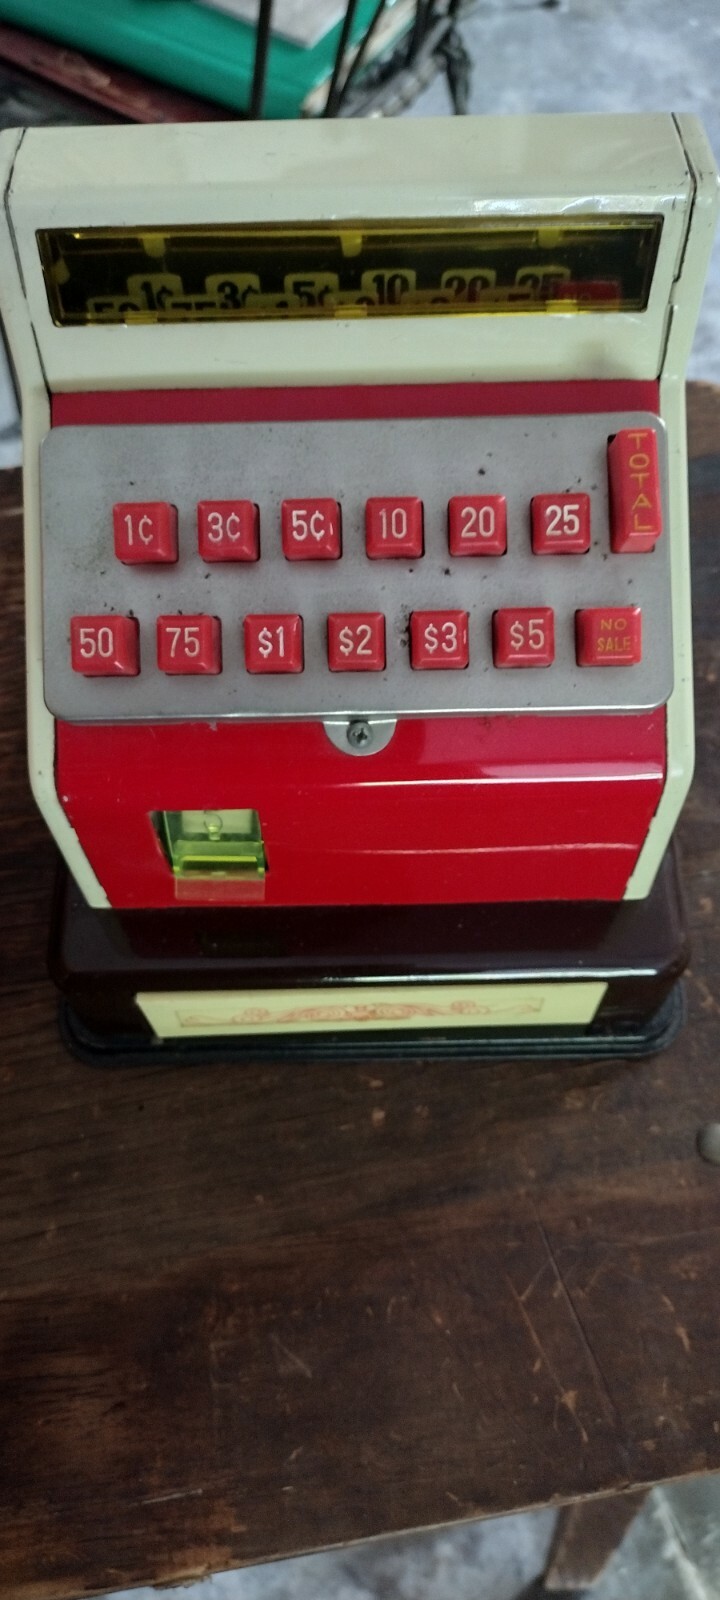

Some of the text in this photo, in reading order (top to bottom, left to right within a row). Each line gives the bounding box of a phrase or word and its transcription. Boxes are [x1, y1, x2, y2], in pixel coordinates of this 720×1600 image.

[373, 274, 410, 305] 10
[627, 432, 652, 532] TOTAL
[124, 514, 153, 545] 1¢
[207, 511, 241, 542] 3¢
[292, 510, 325, 541] 5¢
[378, 507, 407, 539] 10
[460, 506, 495, 538] 20
[545, 504, 580, 536] 25
[339, 624, 372, 656] $2
[424, 622, 457, 654] $3
[510, 619, 545, 651] $5
[600, 618, 627, 630] NO
[79, 626, 113, 658] 50
[165, 626, 200, 658] 75
[258, 625, 285, 659] $1
[596, 636, 631, 652] SALE
